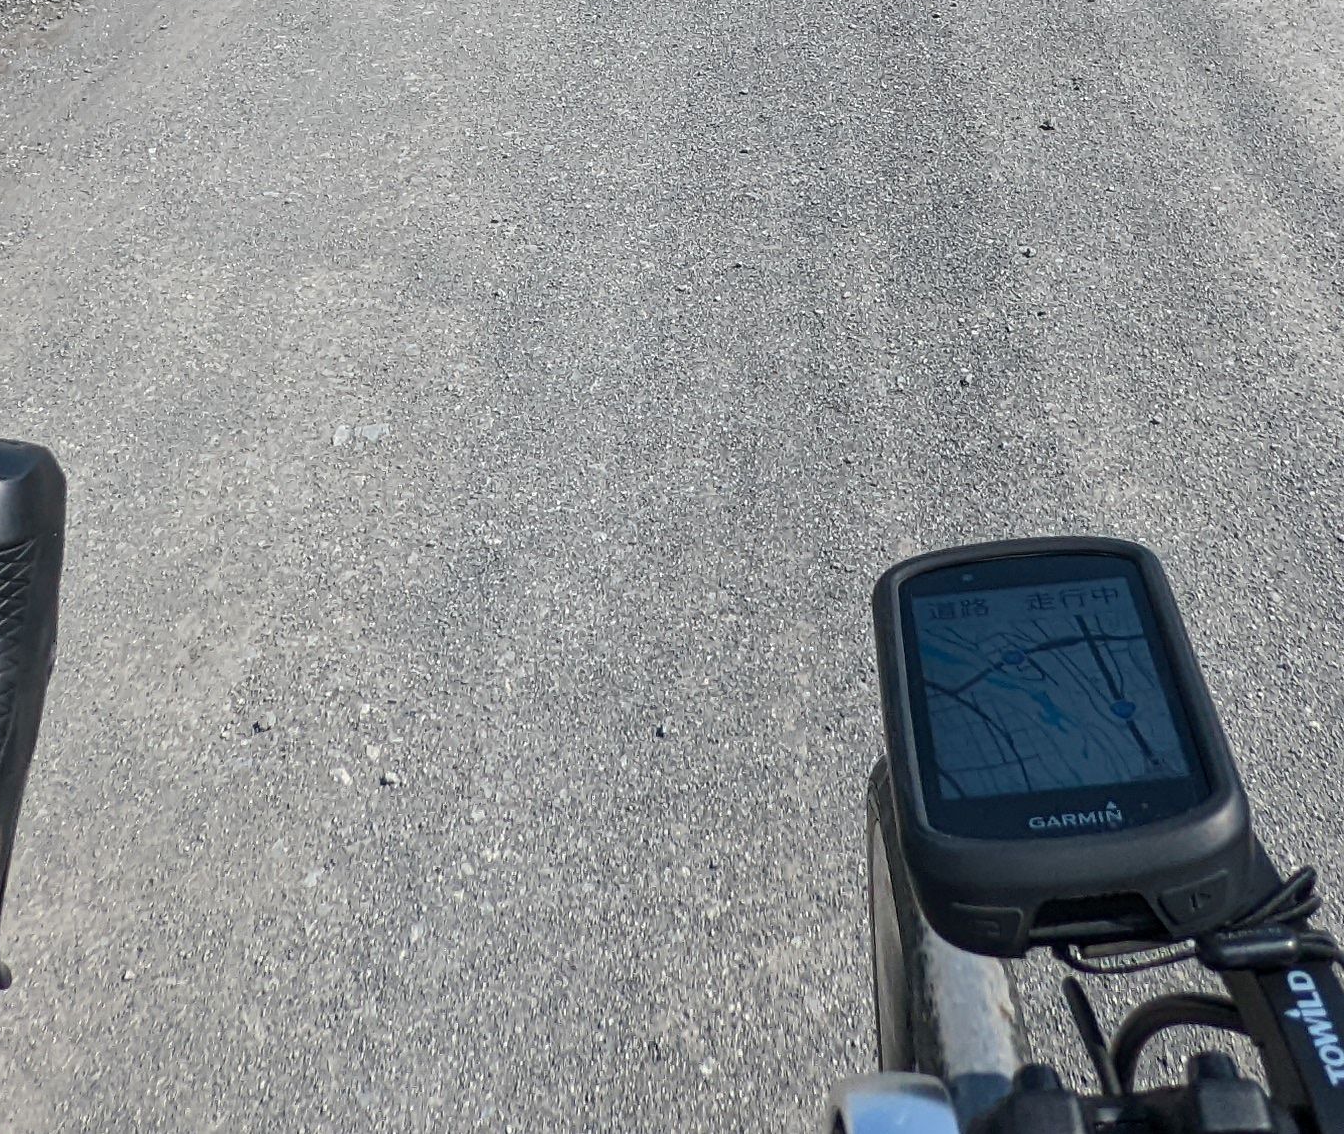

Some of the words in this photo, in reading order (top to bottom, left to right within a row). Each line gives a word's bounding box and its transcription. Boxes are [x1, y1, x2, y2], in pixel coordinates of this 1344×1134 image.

[927, 598, 990, 621] 道路
[1025, 586, 1120, 611] 走行中
[1028, 807, 1123, 829] GARMIN
